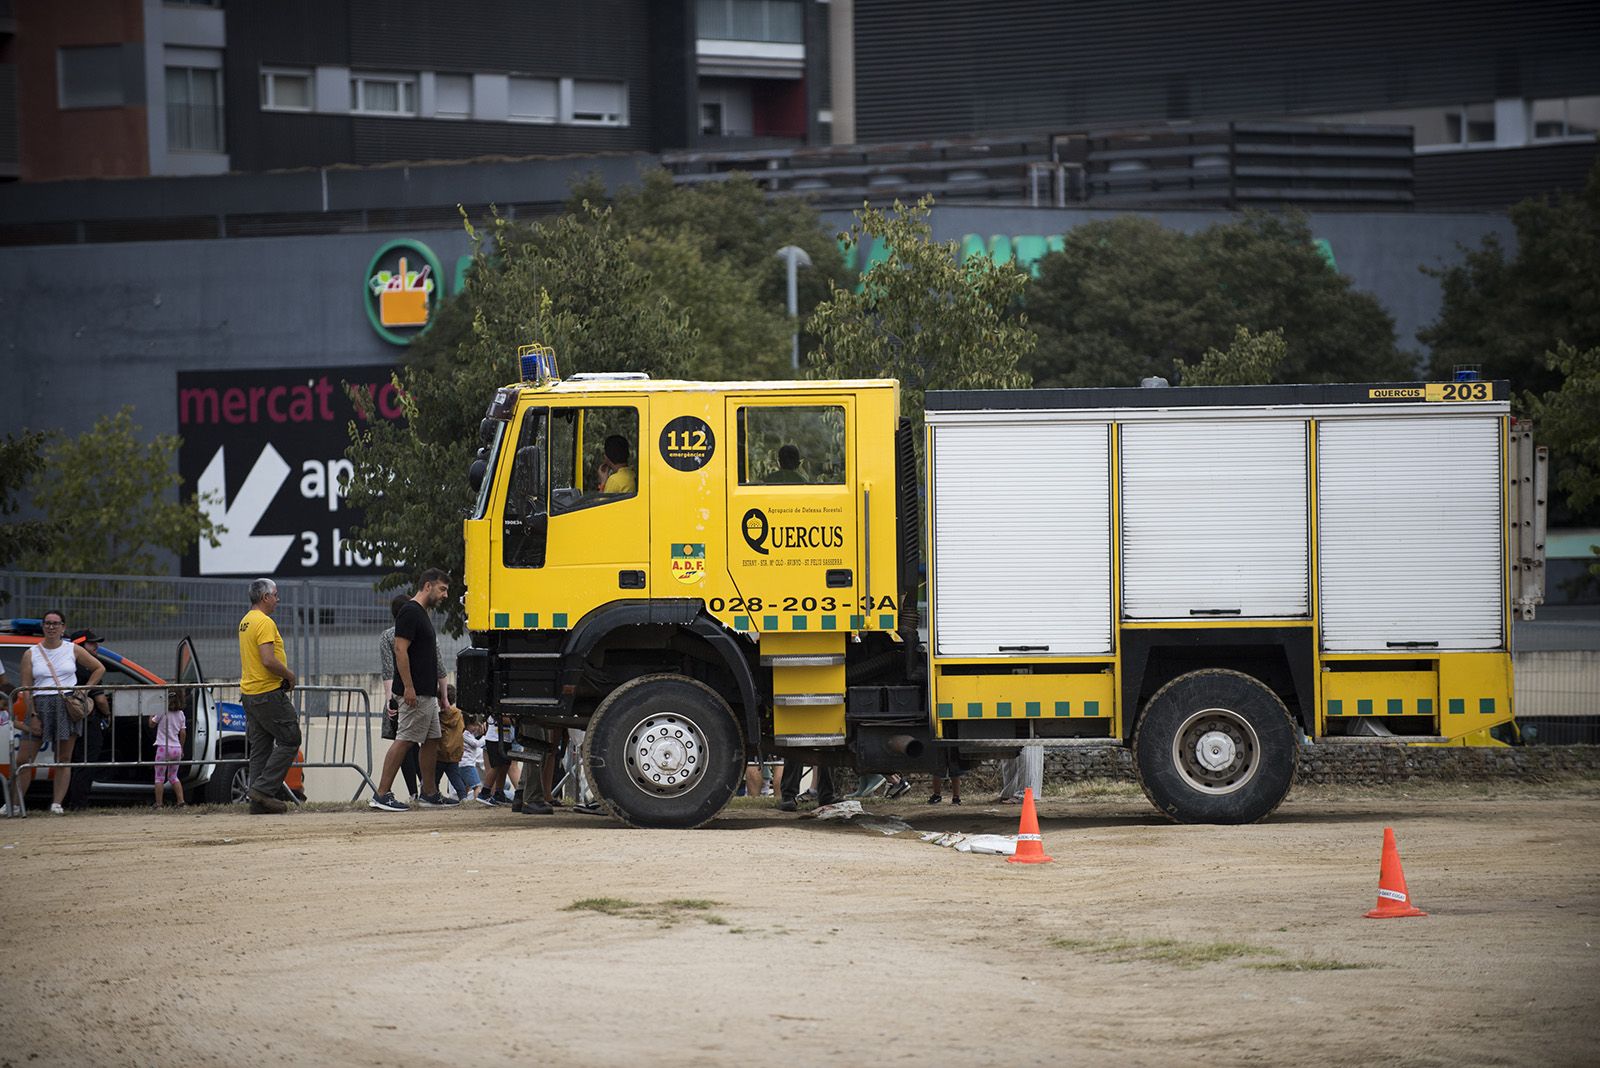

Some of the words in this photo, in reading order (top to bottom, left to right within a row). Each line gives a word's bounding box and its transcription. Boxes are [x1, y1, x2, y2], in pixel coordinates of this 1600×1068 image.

[179, 376, 335, 425] mercat
[1373, 389, 1421, 398] QUERCUS
[1442, 383, 1488, 400] 203
[667, 430, 707, 451] 112
[300, 530, 320, 567] 3
[741, 508, 844, 555] QUERCUS
